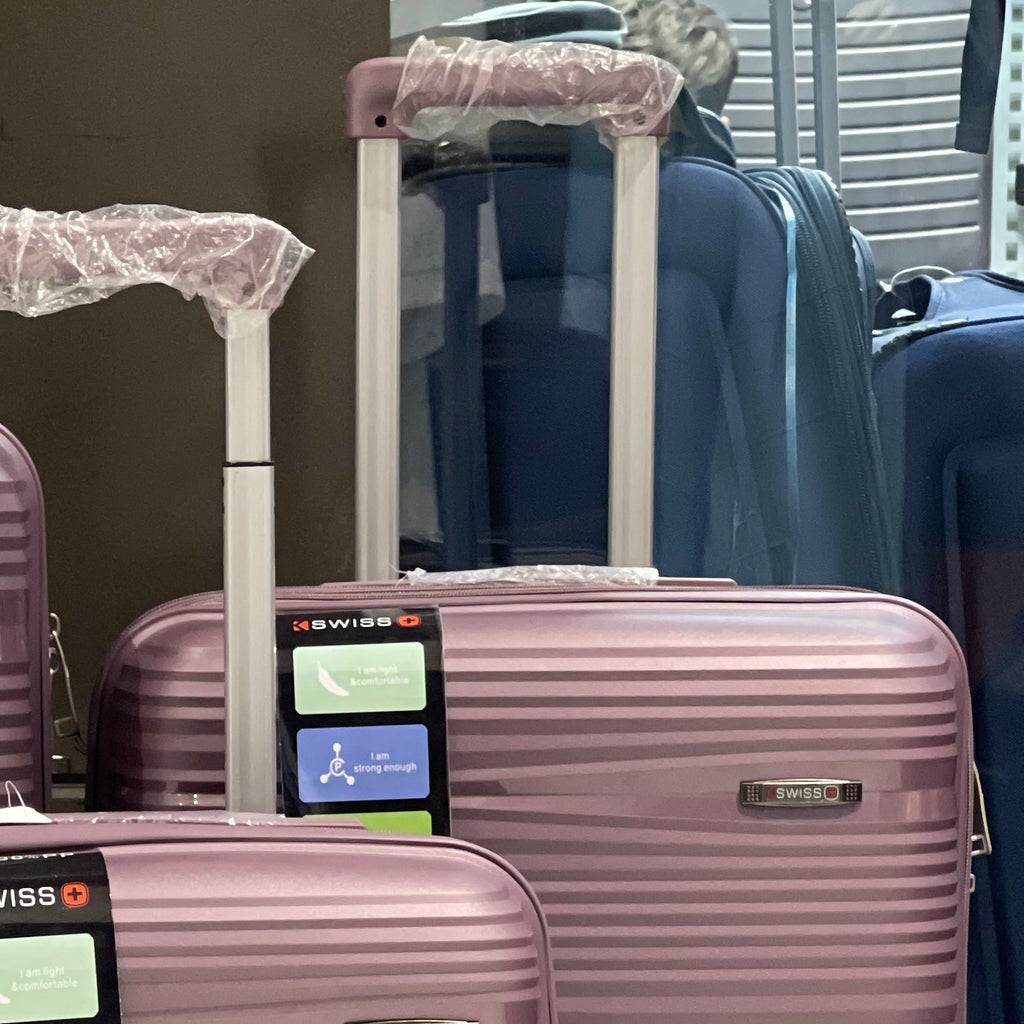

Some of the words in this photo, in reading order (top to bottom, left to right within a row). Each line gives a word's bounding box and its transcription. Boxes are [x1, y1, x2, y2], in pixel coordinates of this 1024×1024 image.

[378, 665, 398, 675] light
[354, 764, 382, 774] strong
[383, 762, 417, 773] enough
[25, 970, 41, 978] am
[43, 967, 65, 978] light
[11, 978, 79, 992] &comfortable
